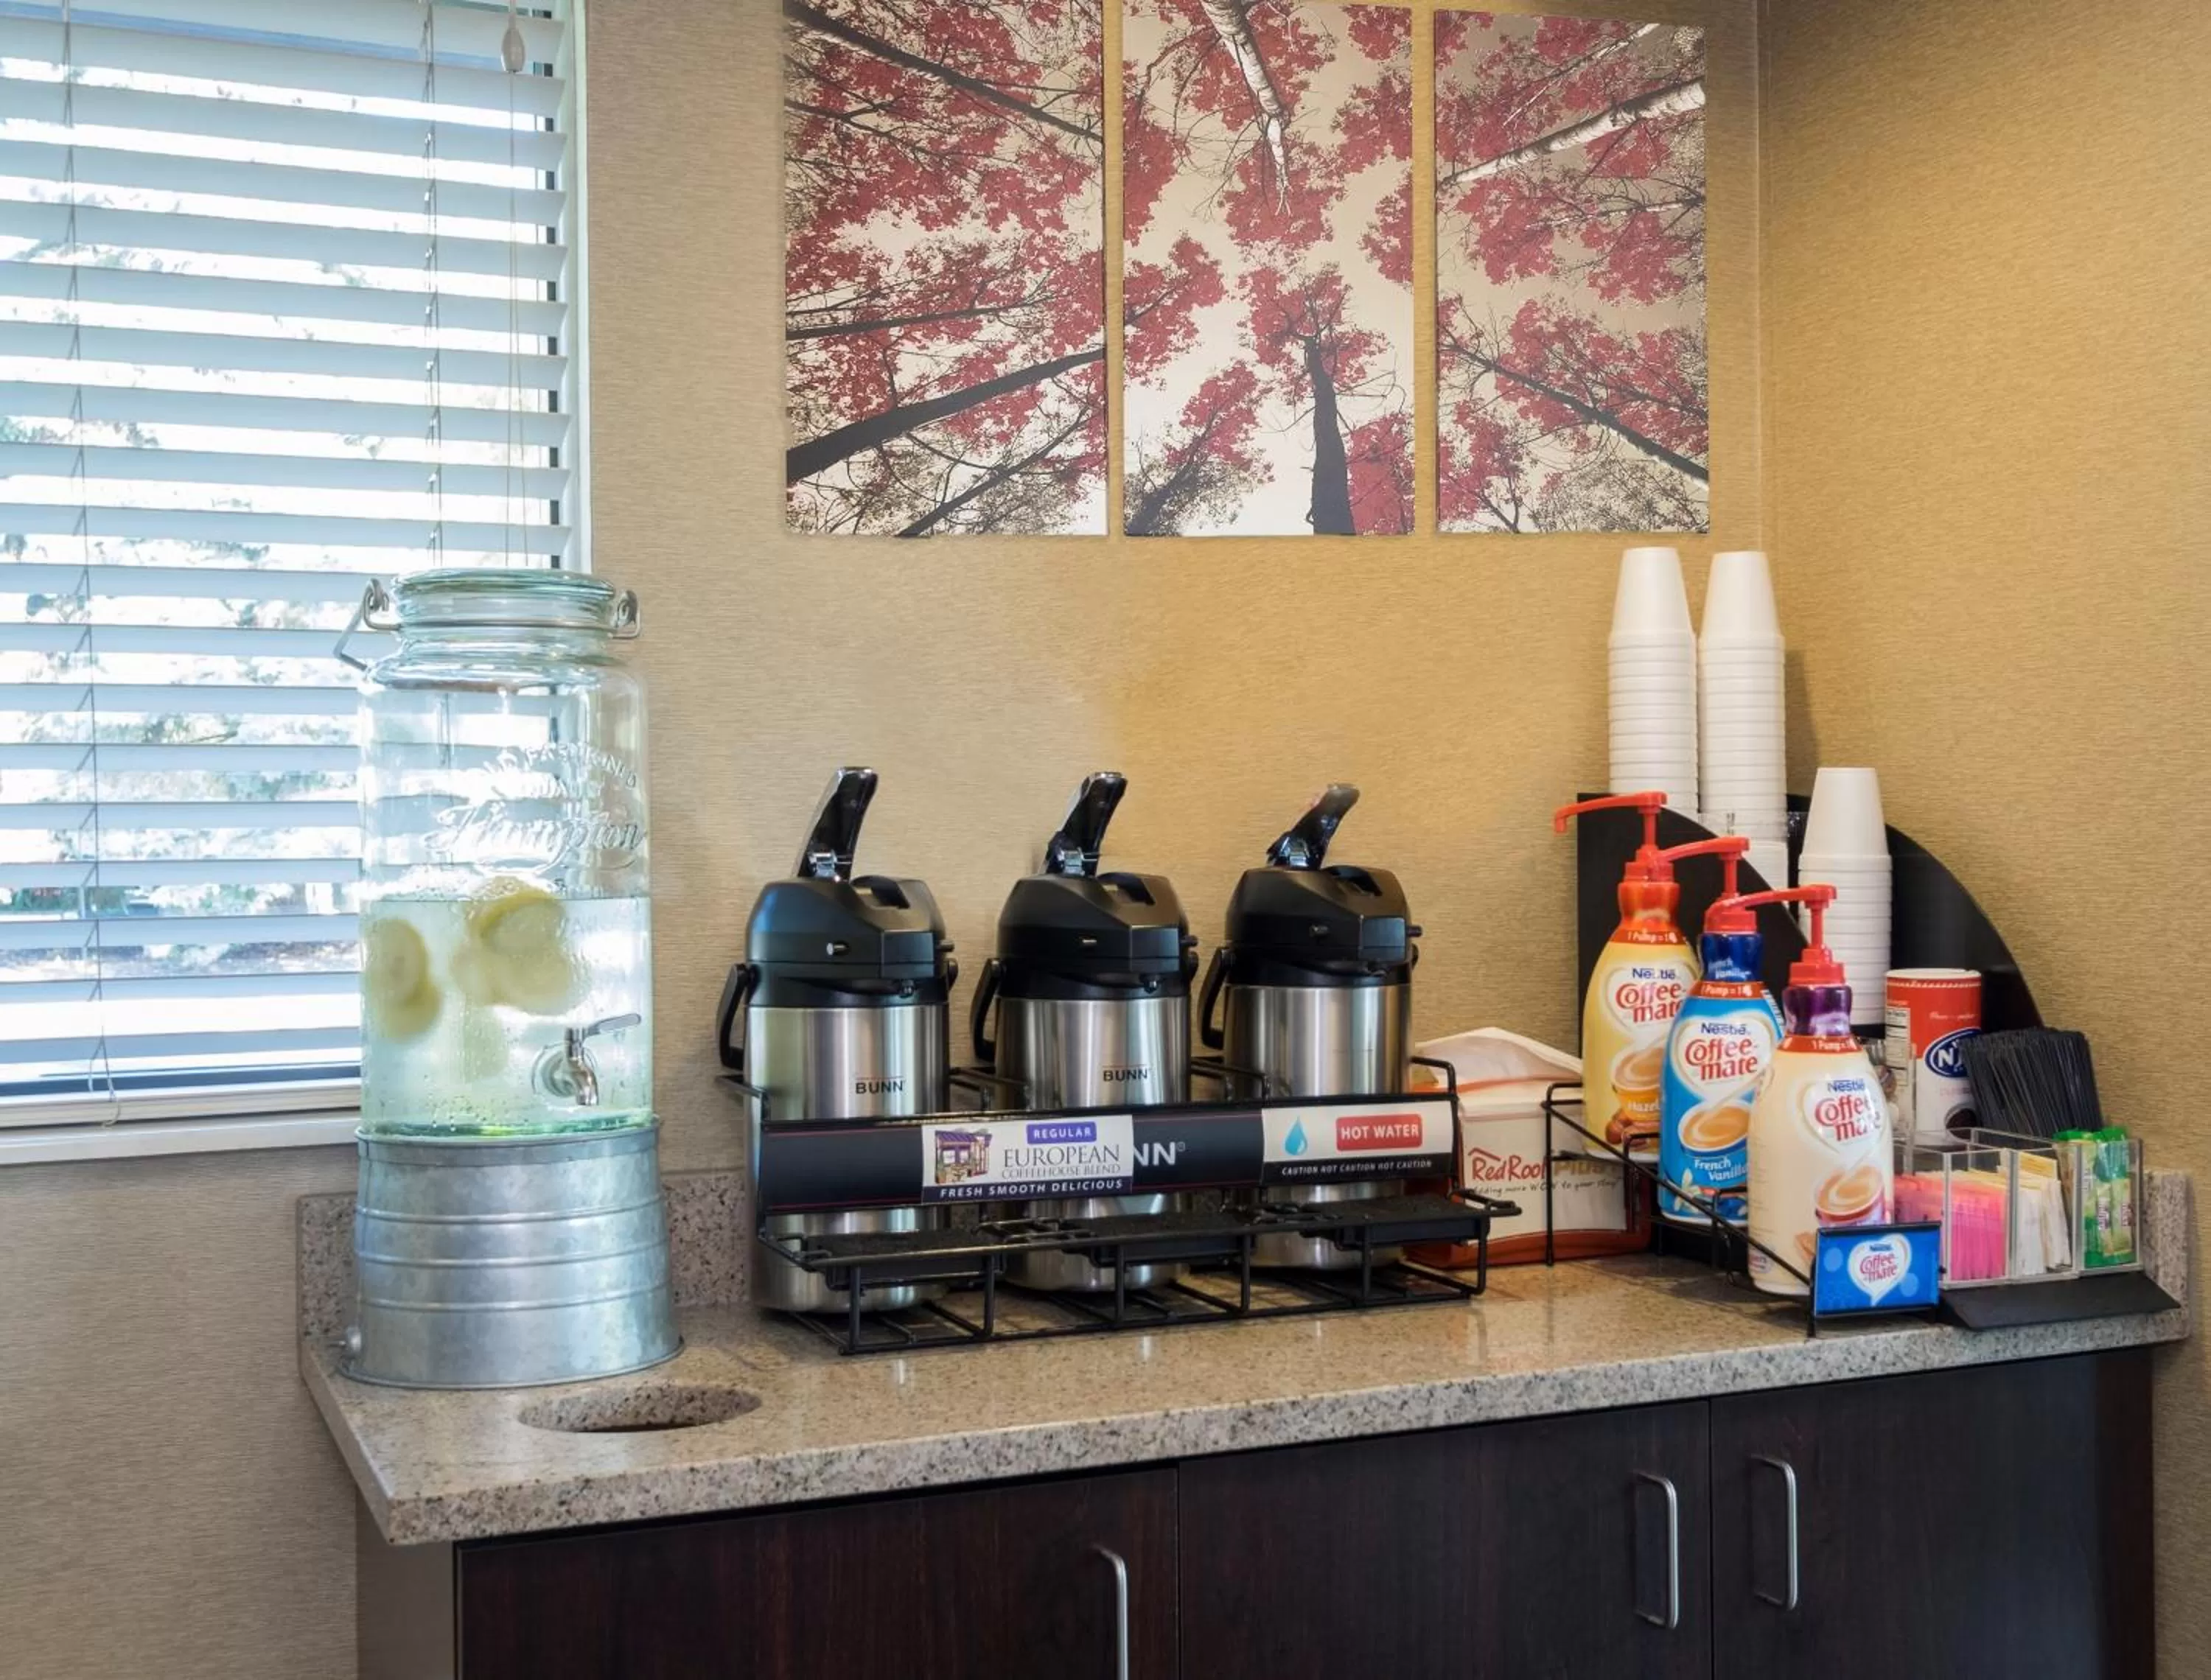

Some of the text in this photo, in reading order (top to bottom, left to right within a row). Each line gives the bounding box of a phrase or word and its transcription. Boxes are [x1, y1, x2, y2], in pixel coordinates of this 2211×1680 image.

[1103, 1068, 1149, 1082] BUNN
[1700, 1057, 1758, 1080] mate
[856, 1080, 904, 1094] BUNN
[1033, 1127, 1093, 1139] REGULAR
[1341, 1123, 1419, 1141] HOT WATER
[1003, 1144, 1120, 1168] EUROPEAN
[1693, 1155, 1731, 1171] French
[1002, 1163, 1121, 1179] COFFEEHOUSE BLEND
[1282, 1159, 1433, 1177] CAUTION HOT CAUTION HOT CAUTION
[940, 1179, 1123, 1199] FRESH SMOOTH DELICIOUS
[1868, 1264, 1899, 1283] mate
